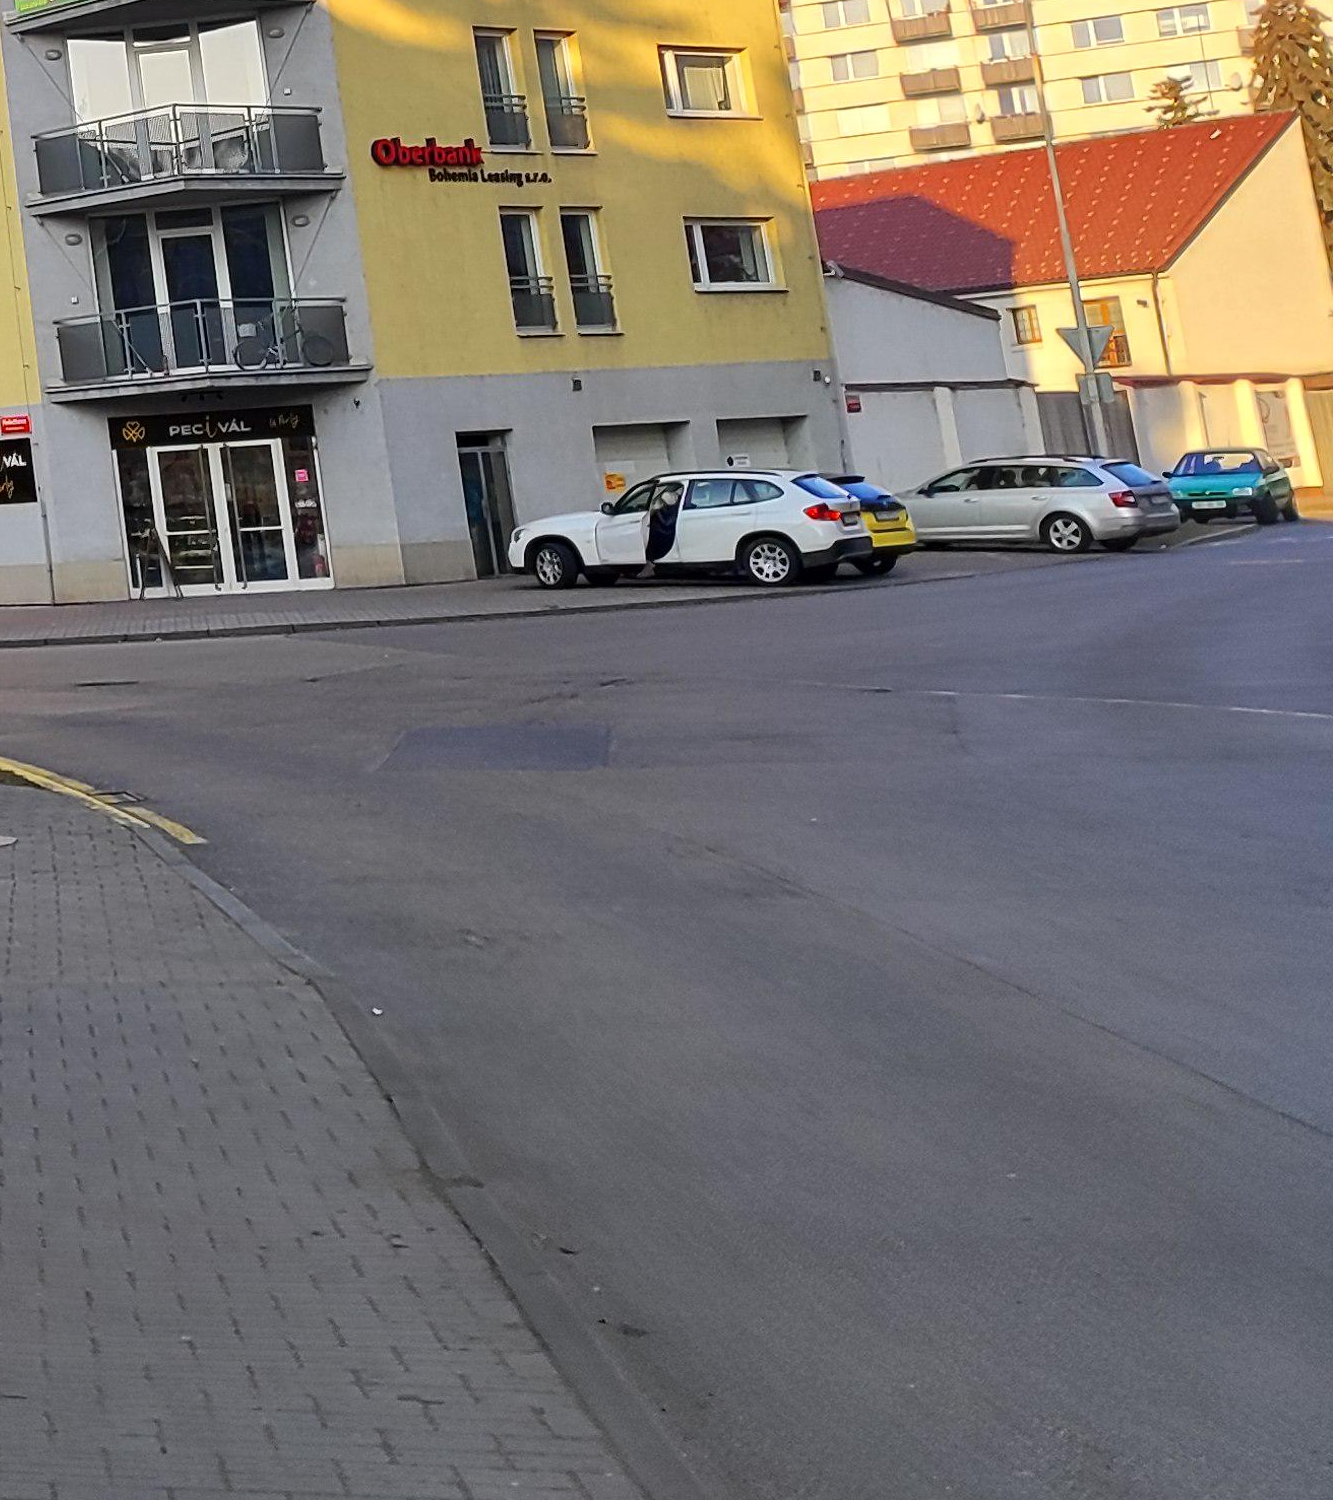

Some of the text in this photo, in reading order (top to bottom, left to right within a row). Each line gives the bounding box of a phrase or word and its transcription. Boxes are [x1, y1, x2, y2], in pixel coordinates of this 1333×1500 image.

[371, 137, 485, 167] Oberbank
[428, 168, 479, 183] Bohemia
[480, 169, 524, 187] Leasing
